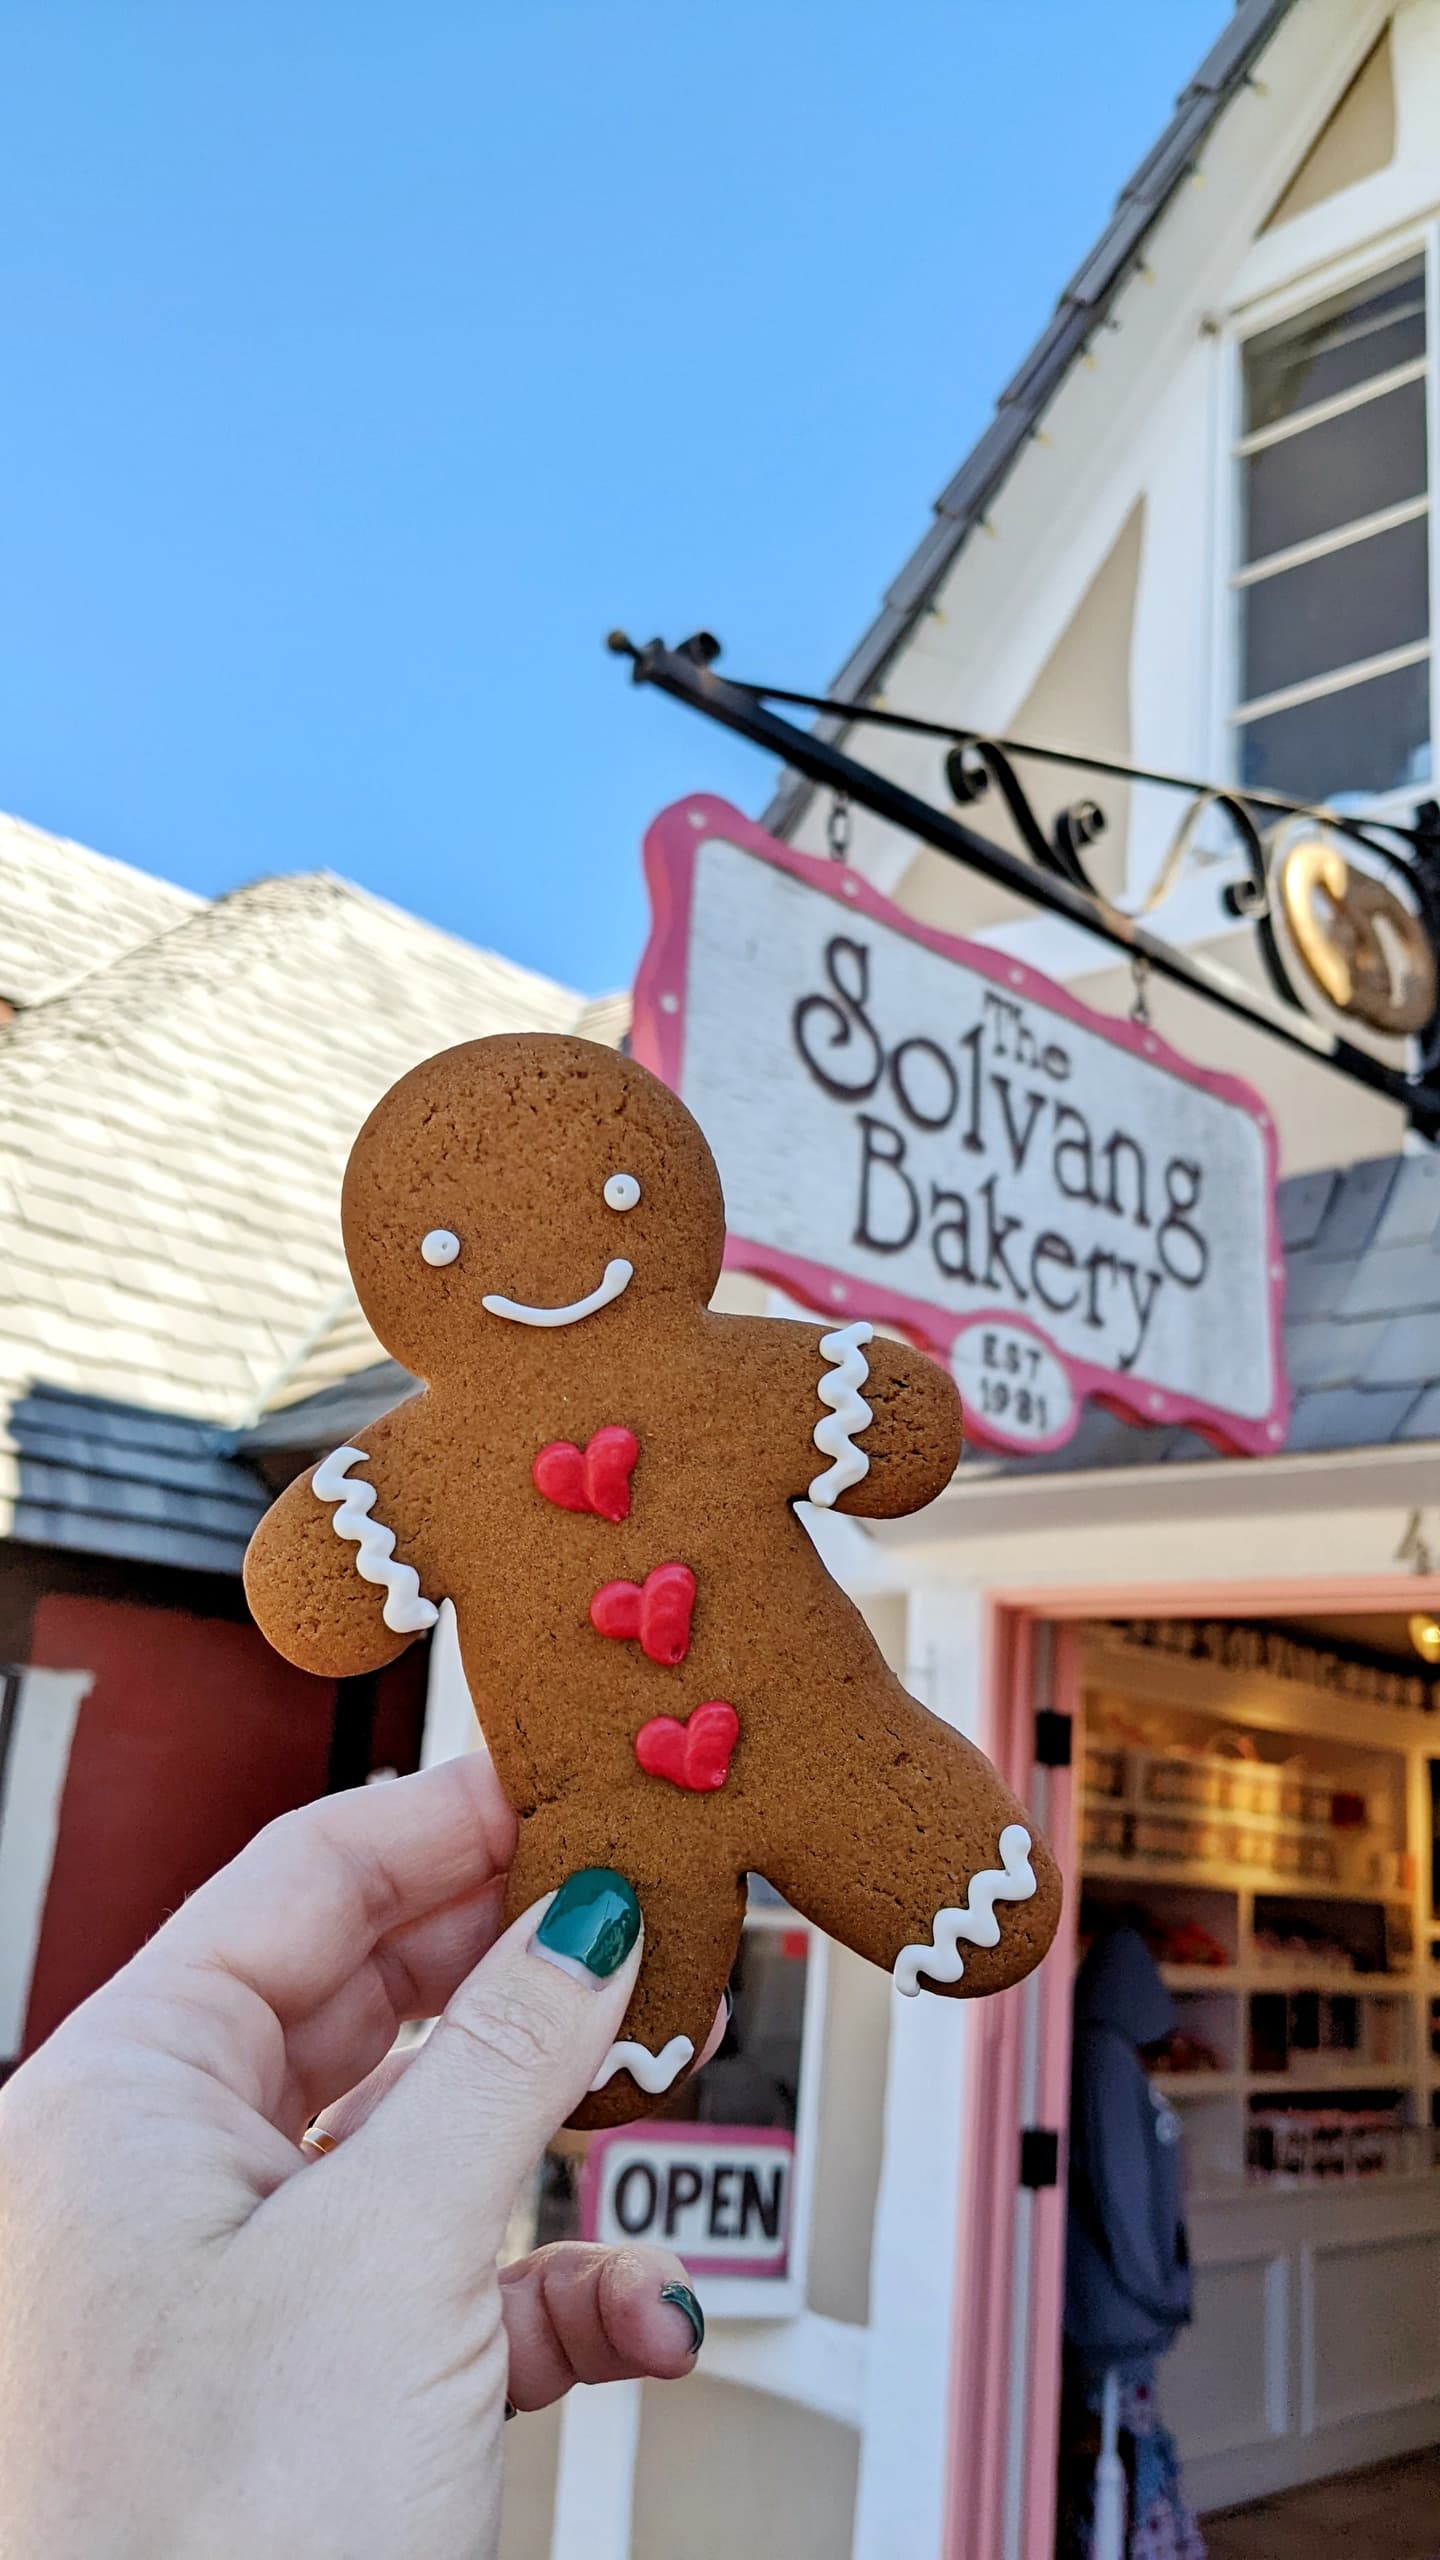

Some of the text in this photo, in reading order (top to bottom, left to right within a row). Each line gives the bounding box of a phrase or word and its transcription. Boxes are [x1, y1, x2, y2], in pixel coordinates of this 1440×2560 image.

[985, 993, 1071, 1081] The
[793, 937, 1208, 1287] Solvang
[853, 1113, 1163, 1370] Bakery
[983, 1333, 1042, 1379] EST
[615, 2160, 783, 2238] OPEN
